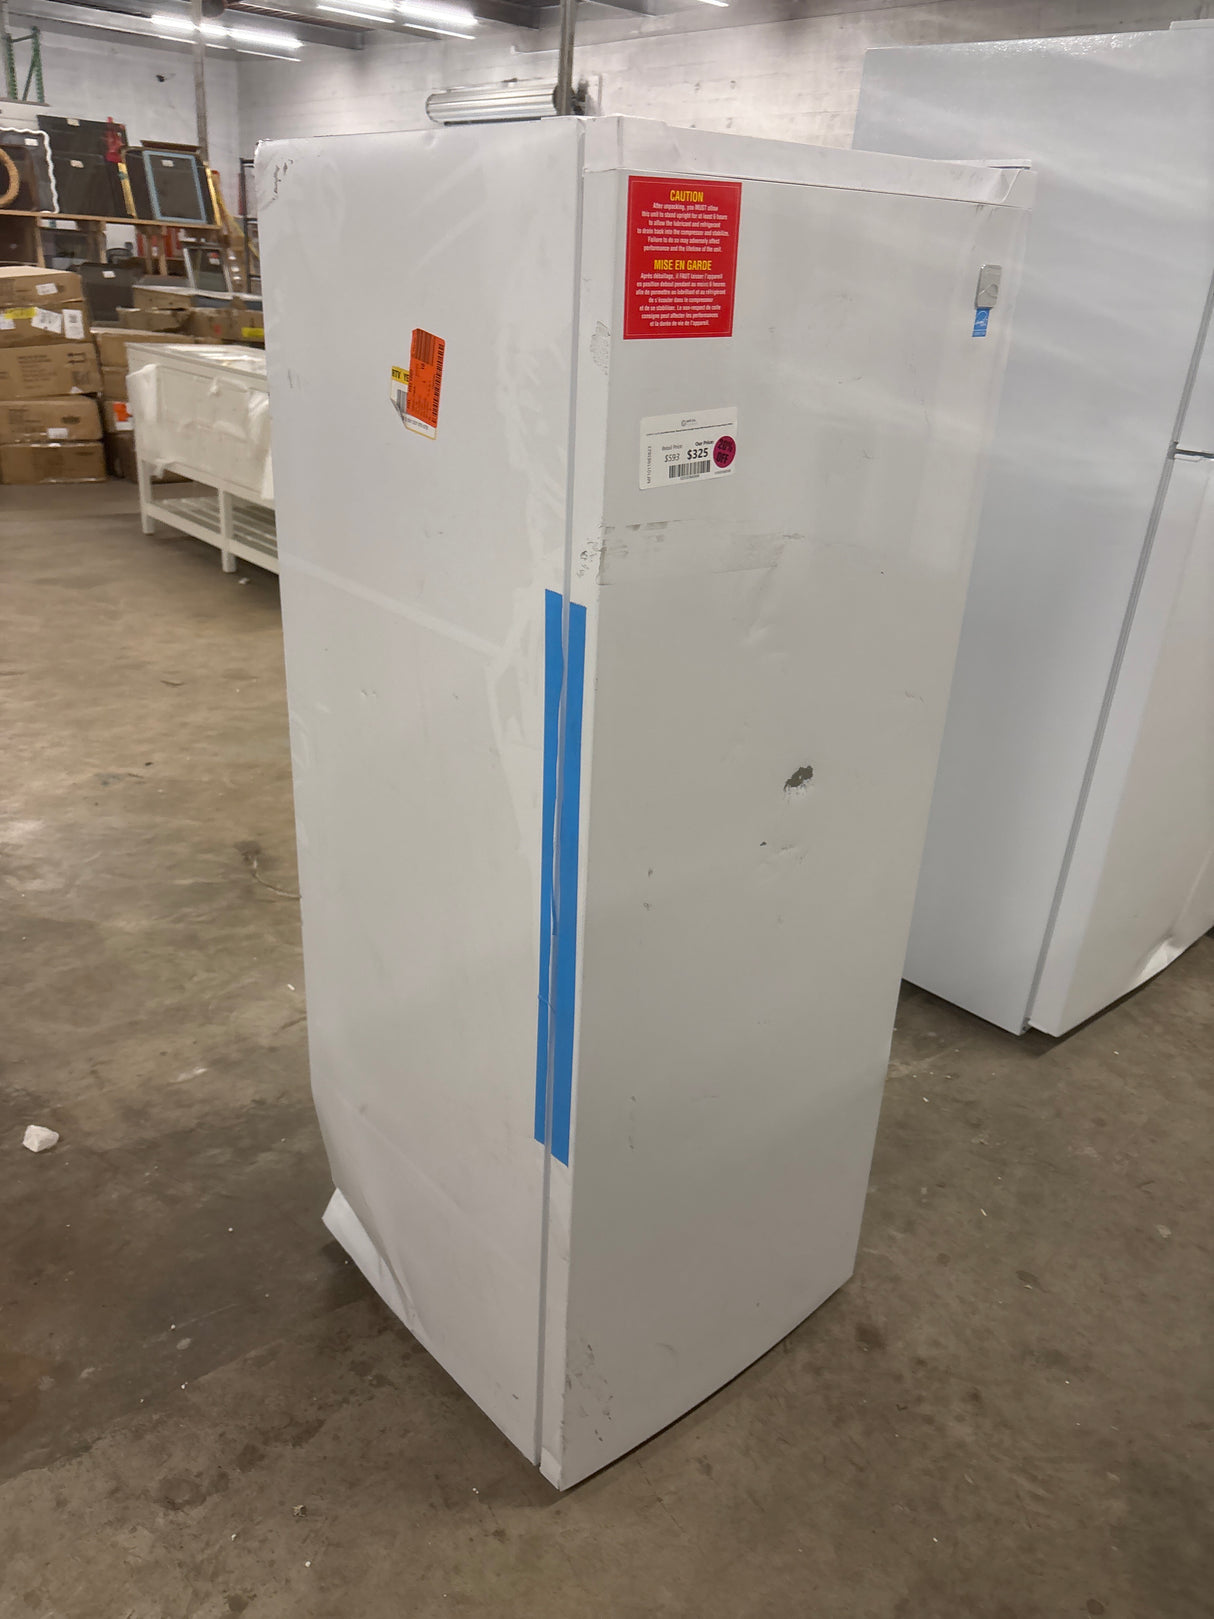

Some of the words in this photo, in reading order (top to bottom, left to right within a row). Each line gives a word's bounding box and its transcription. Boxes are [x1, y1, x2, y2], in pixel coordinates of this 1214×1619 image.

[670, 190, 704, 202] CAUTION
[654, 260, 673, 270] MISE
[675, 260, 685, 270] EN
[687, 260, 712, 270] GARDE
[687, 448, 708, 460] $325
[716, 452, 729, 464] OFF
